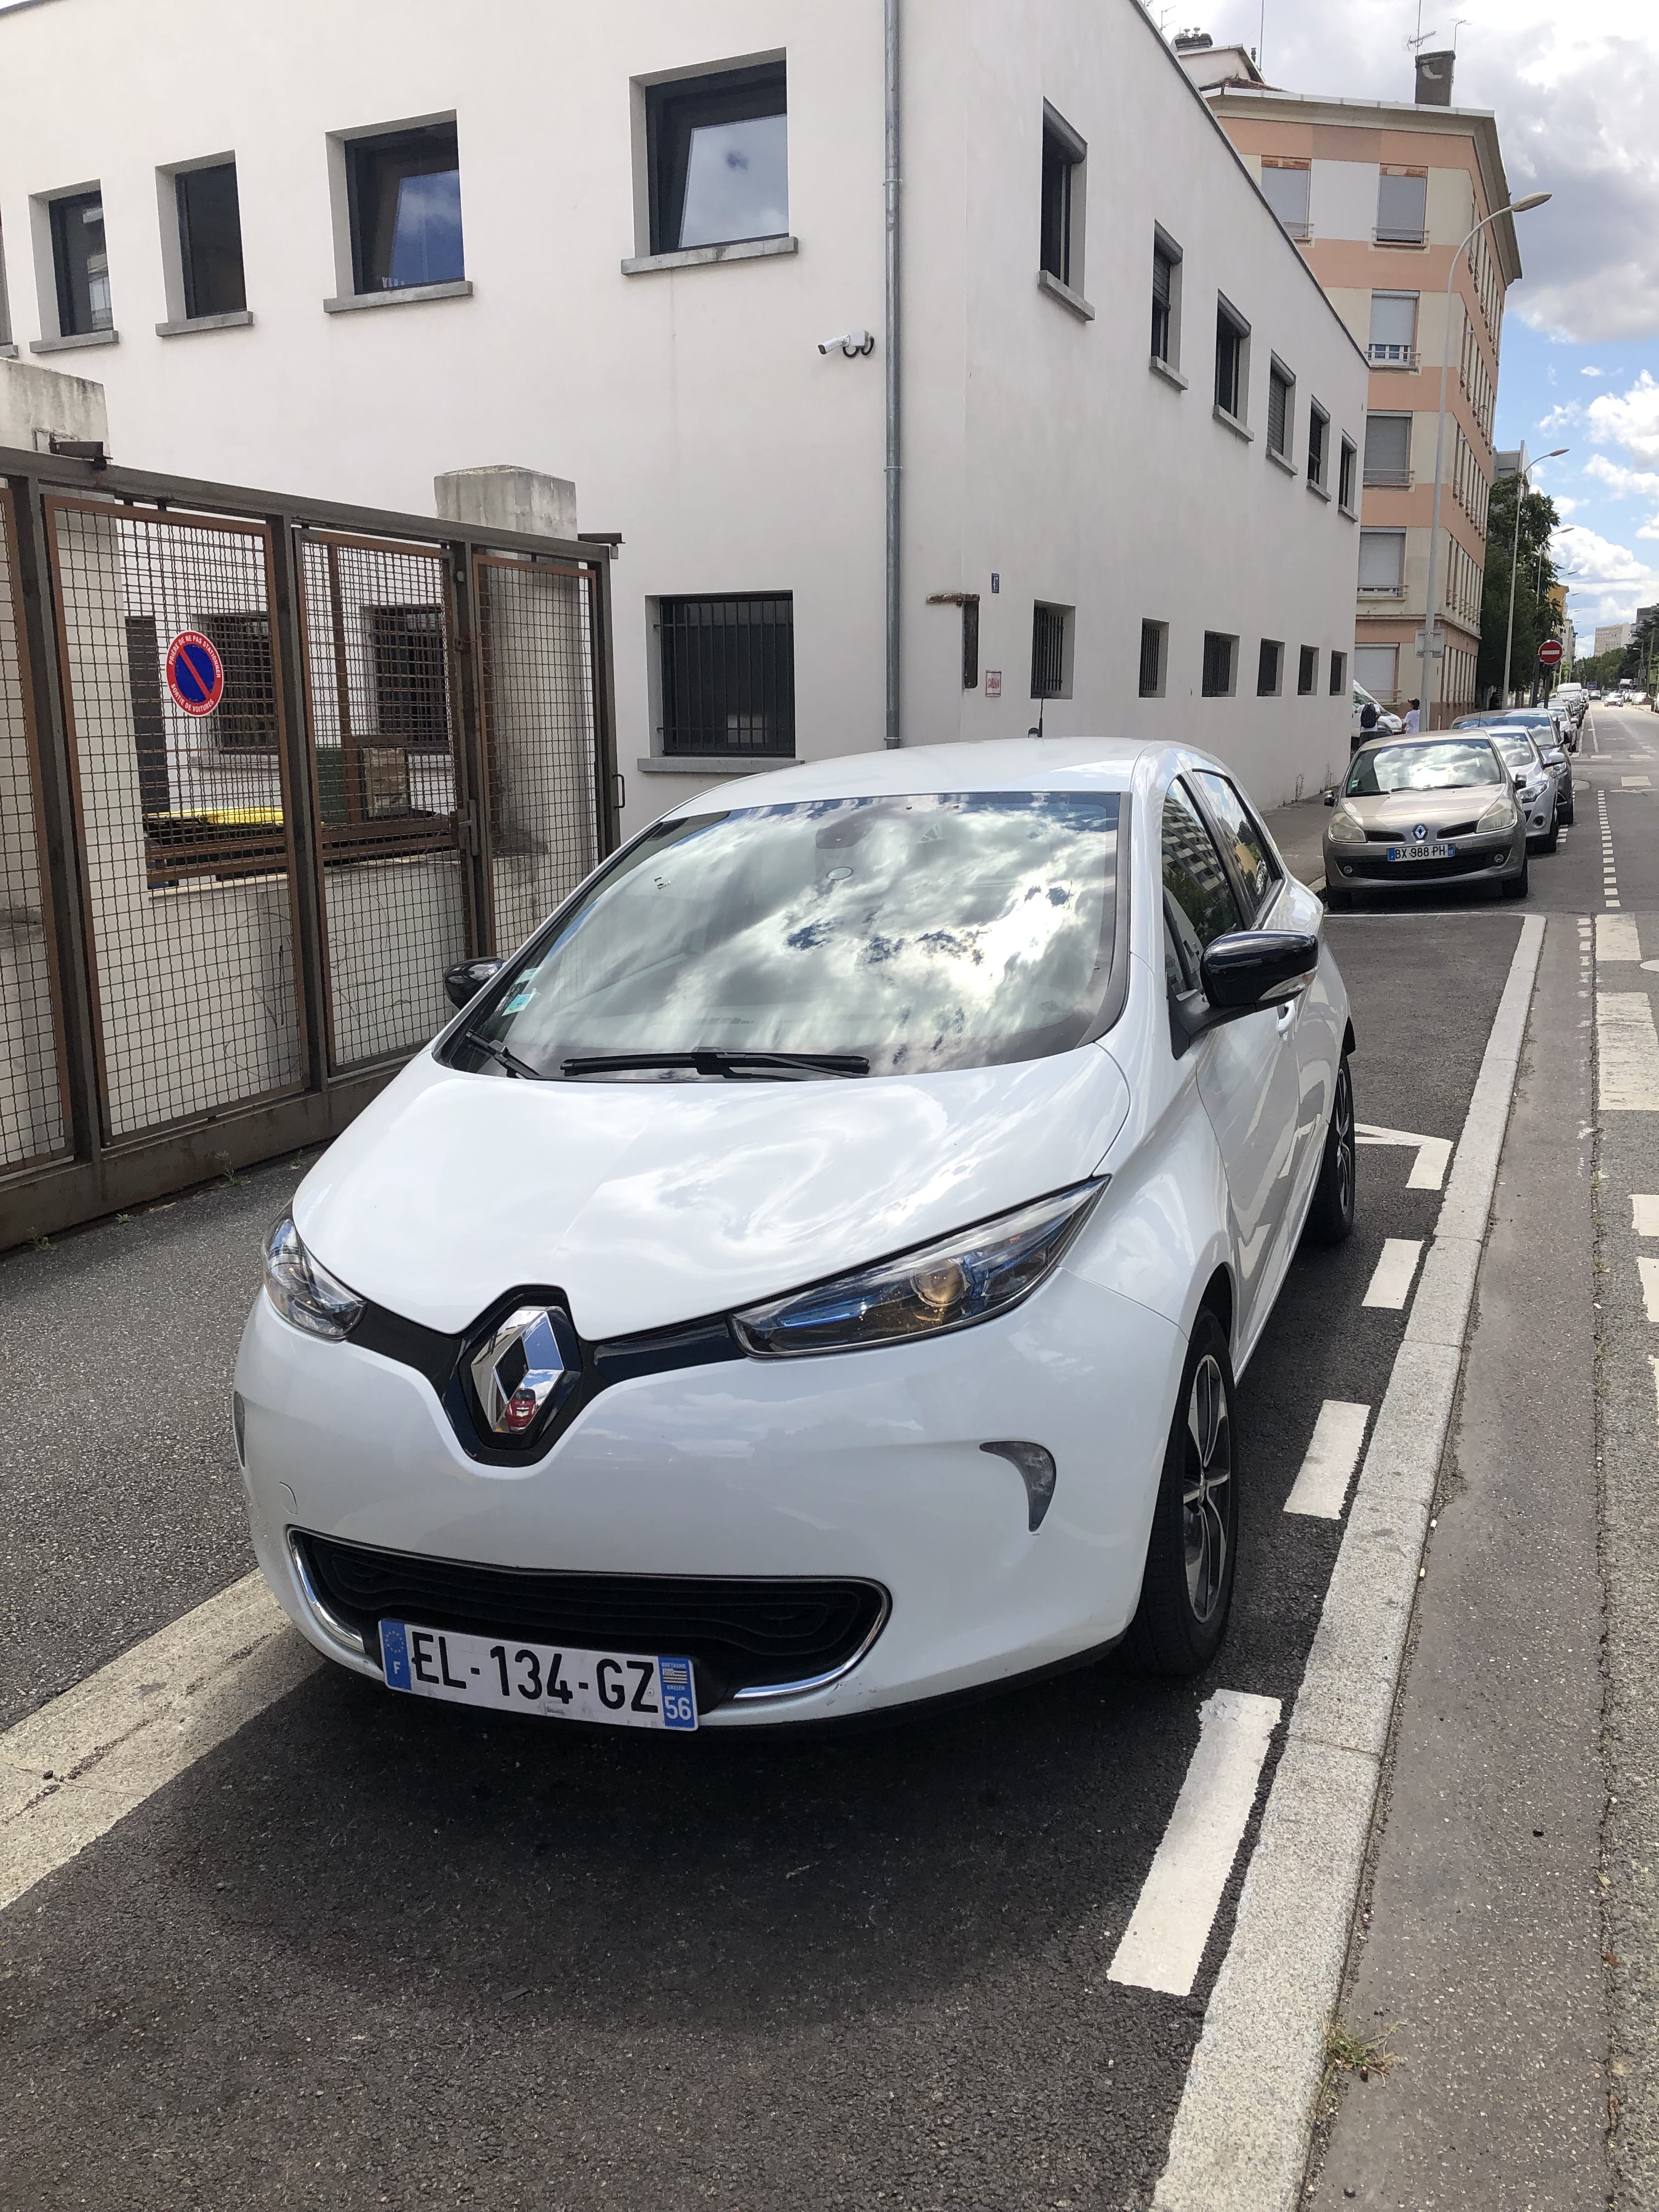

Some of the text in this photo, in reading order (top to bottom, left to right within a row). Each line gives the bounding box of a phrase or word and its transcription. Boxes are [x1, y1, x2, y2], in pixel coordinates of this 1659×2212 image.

[178, 637, 185, 646] DE
[193, 635, 202, 644] PAS
[202, 641, 221, 678] STATIONNER
[171, 684, 214, 713] SORTIE DE VOITURES
[393, 1661, 400, 1674] F
[664, 1696, 691, 1720] 56
